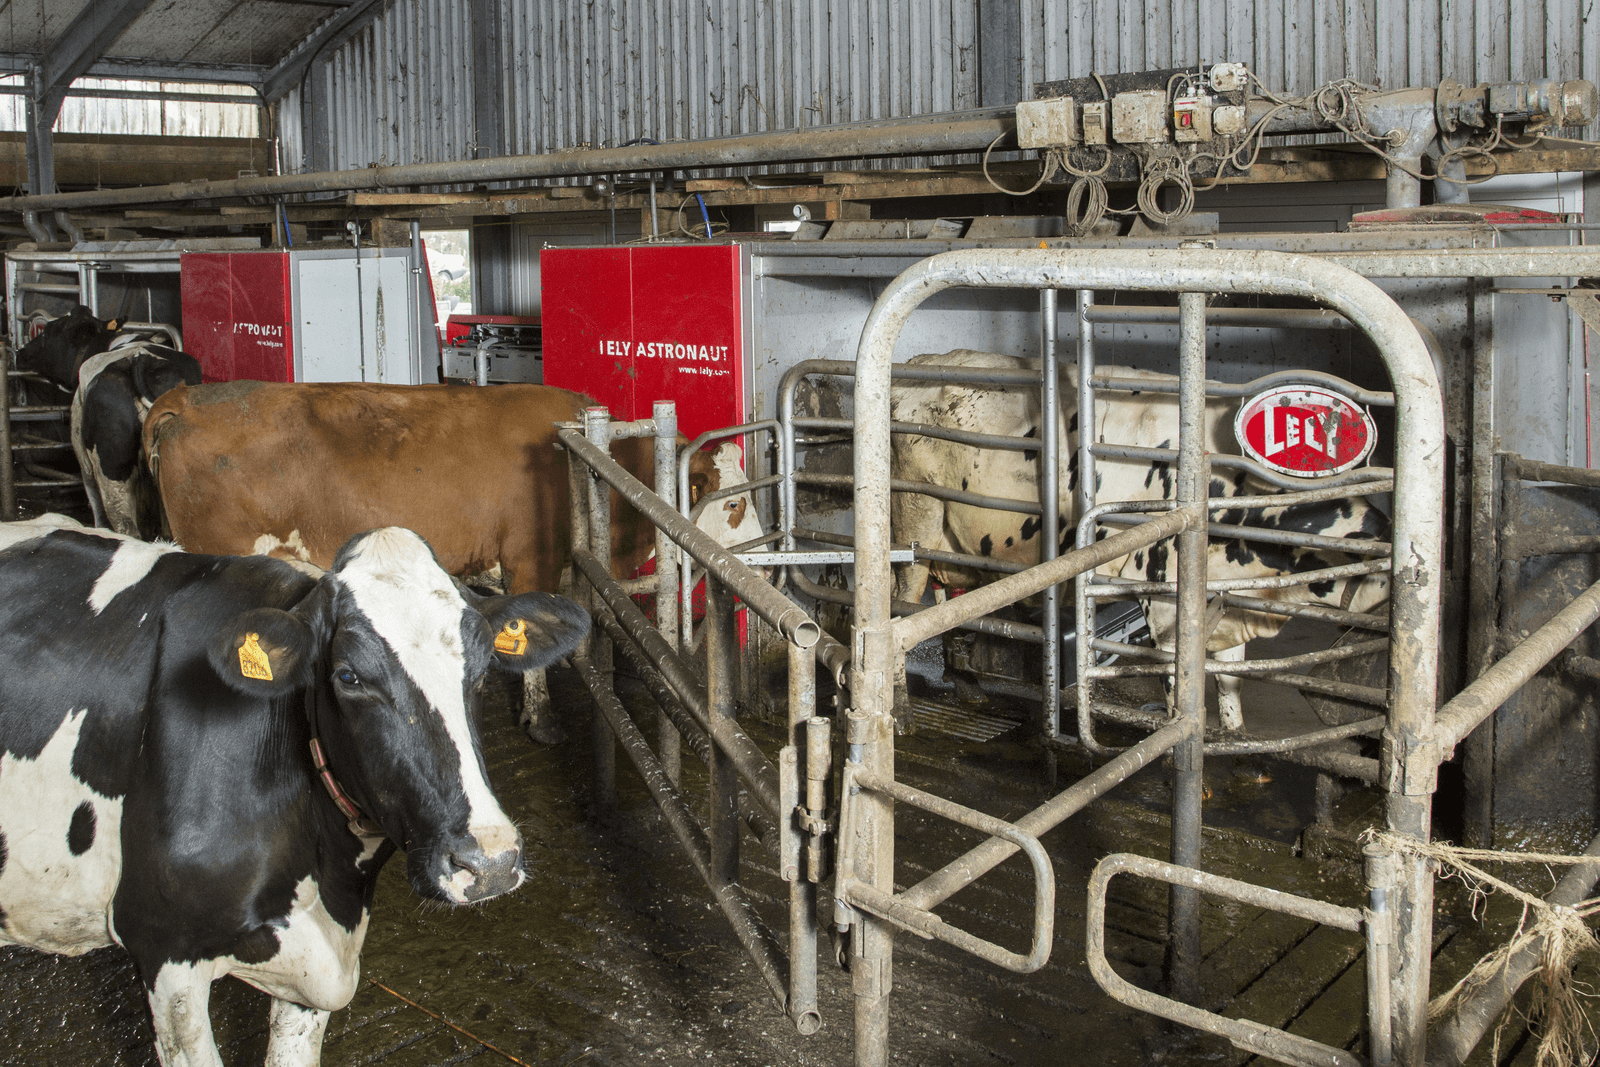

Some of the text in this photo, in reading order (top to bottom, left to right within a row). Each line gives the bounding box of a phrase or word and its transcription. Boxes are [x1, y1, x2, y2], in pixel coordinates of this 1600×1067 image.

[636, 342, 728, 362] ASTRONAUT
[678, 366, 730, 377] wwwlely.com
[1264, 402, 1341, 460] LELY
